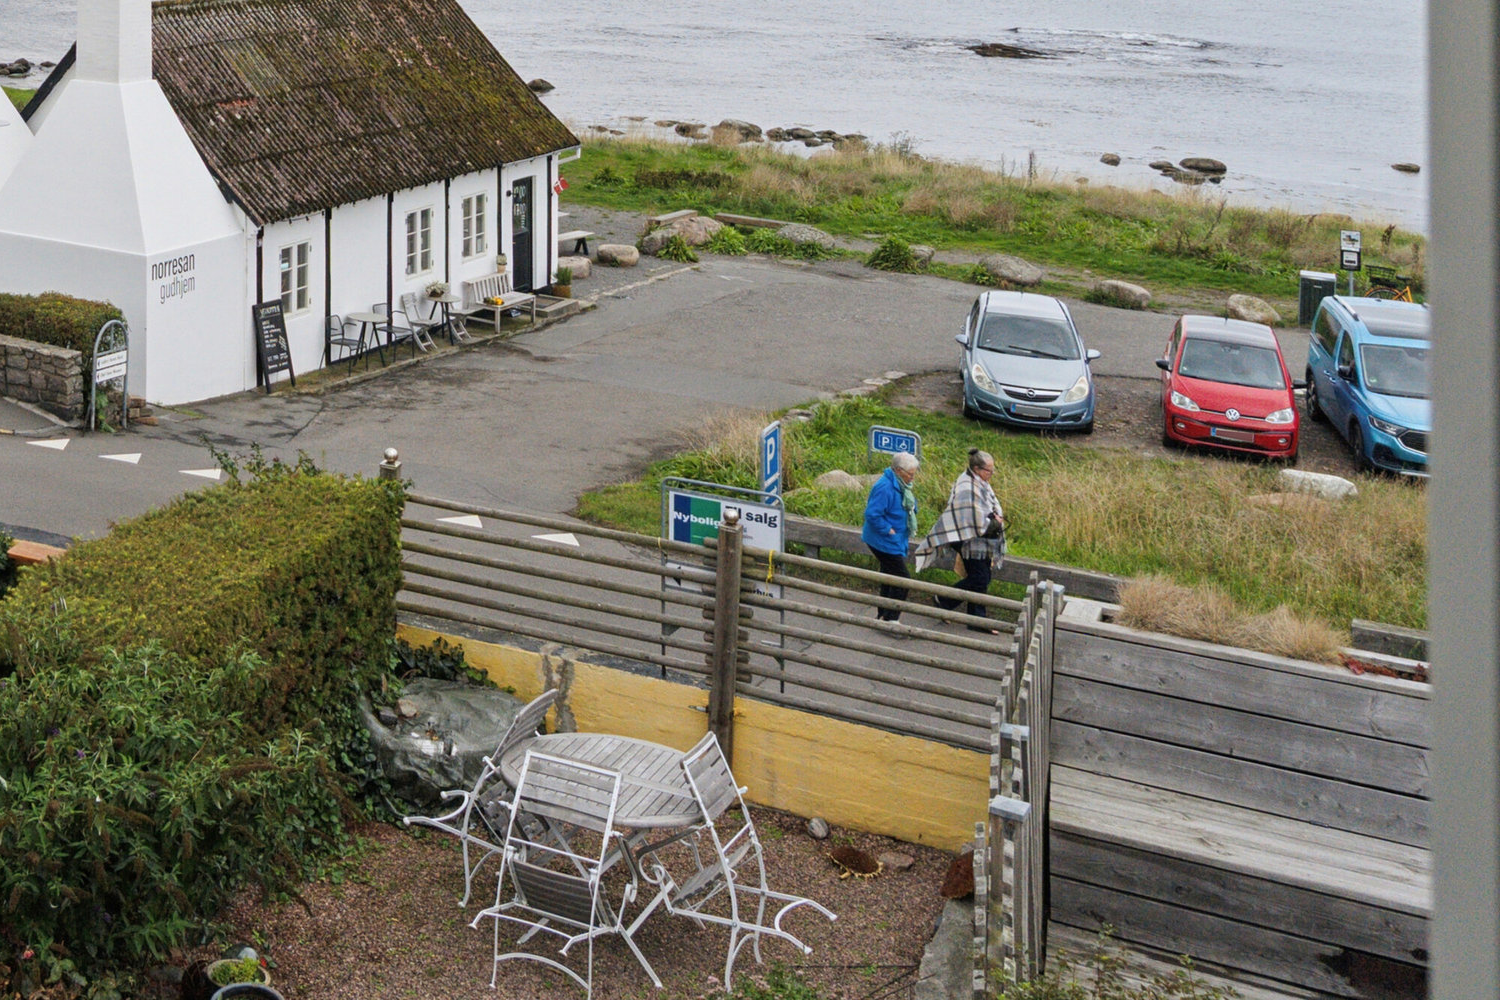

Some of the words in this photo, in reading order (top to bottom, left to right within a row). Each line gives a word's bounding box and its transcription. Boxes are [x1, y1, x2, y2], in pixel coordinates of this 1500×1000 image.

[151, 254, 195, 281] norresan
[160, 275, 195, 304] gudhjem
[882, 436, 890, 446] P
[766, 436, 775, 476] P
[745, 512, 778, 528] salg
